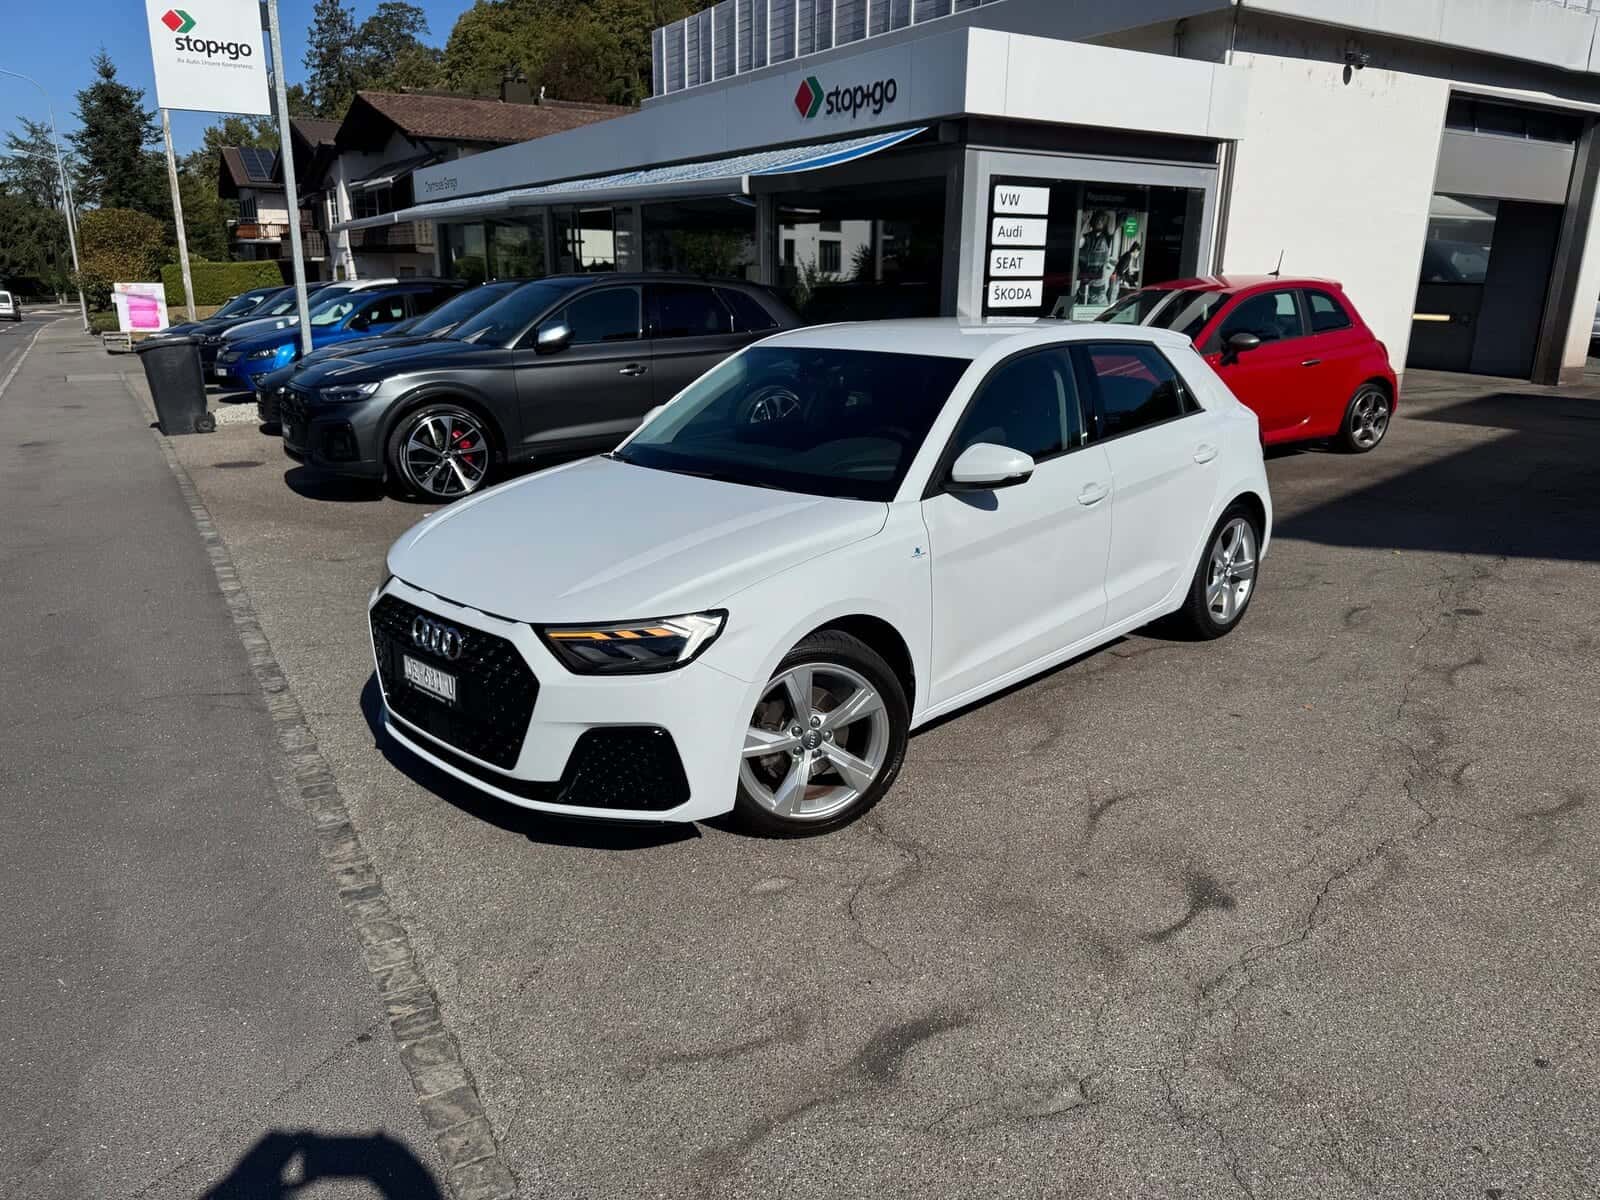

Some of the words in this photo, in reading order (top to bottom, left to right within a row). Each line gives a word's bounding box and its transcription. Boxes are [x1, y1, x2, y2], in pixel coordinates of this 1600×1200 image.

[175, 35, 252, 60] stop+go
[825, 78, 897, 119] stop+go
[1000, 192, 1021, 206] VW
[997, 225, 1023, 238] Audi
[995, 256, 1024, 269] SEAT
[994, 285, 1032, 300] ŠKODA
